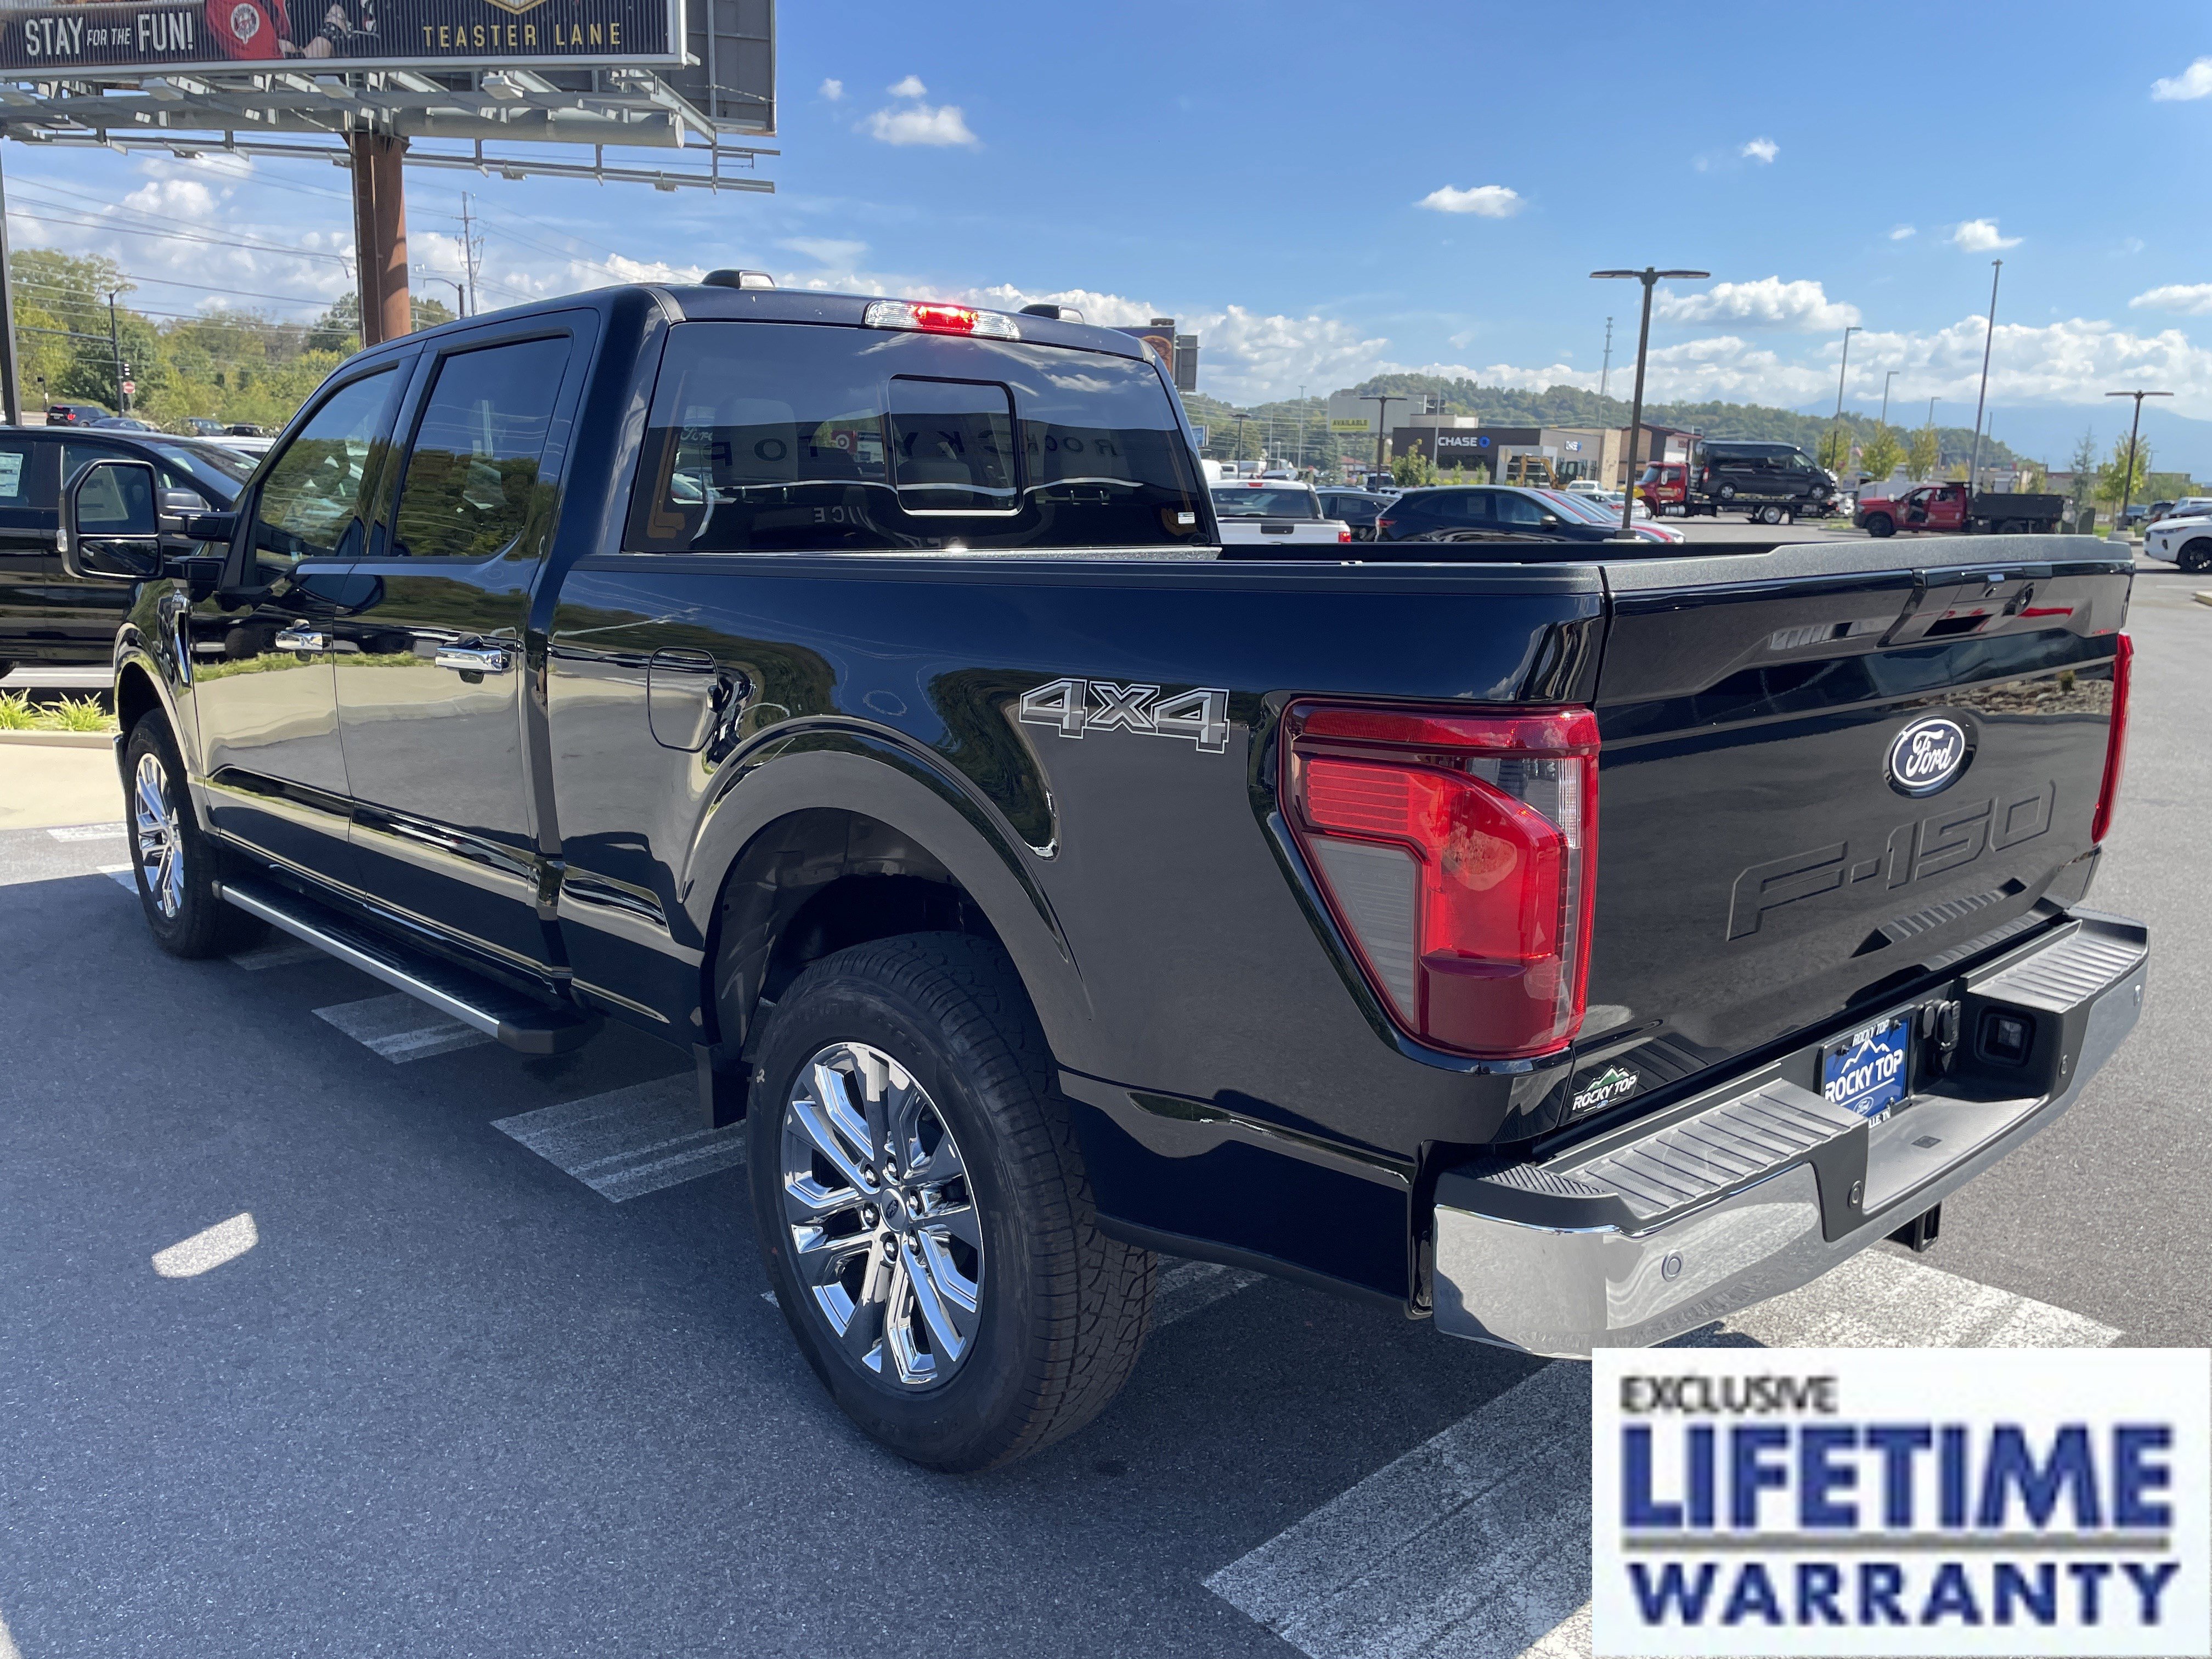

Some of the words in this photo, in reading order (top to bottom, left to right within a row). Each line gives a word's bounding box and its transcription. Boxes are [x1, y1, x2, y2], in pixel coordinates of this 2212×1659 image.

[25, 17, 83, 55] STAY
[87, 29, 107, 46] FOR
[111, 28, 131, 45] THE
[137, 12, 193, 52] FUN!
[423, 24, 537, 47] TEASTER
[555, 22, 620, 46] LANE
[1438, 437, 1478, 447] CHASE
[1905, 729, 1954, 777] Ford
[1726, 780, 2056, 941] F-150
[1852, 1026, 1876, 1047] ROCKY
[1876, 1019, 1890, 1036] TOP
[1572, 1084, 1614, 1110] ROCKY
[1614, 1075, 1637, 1095] TOP
[1825, 1062, 1874, 1103] ROCKY
[1875, 1049, 1904, 1081] TOP
